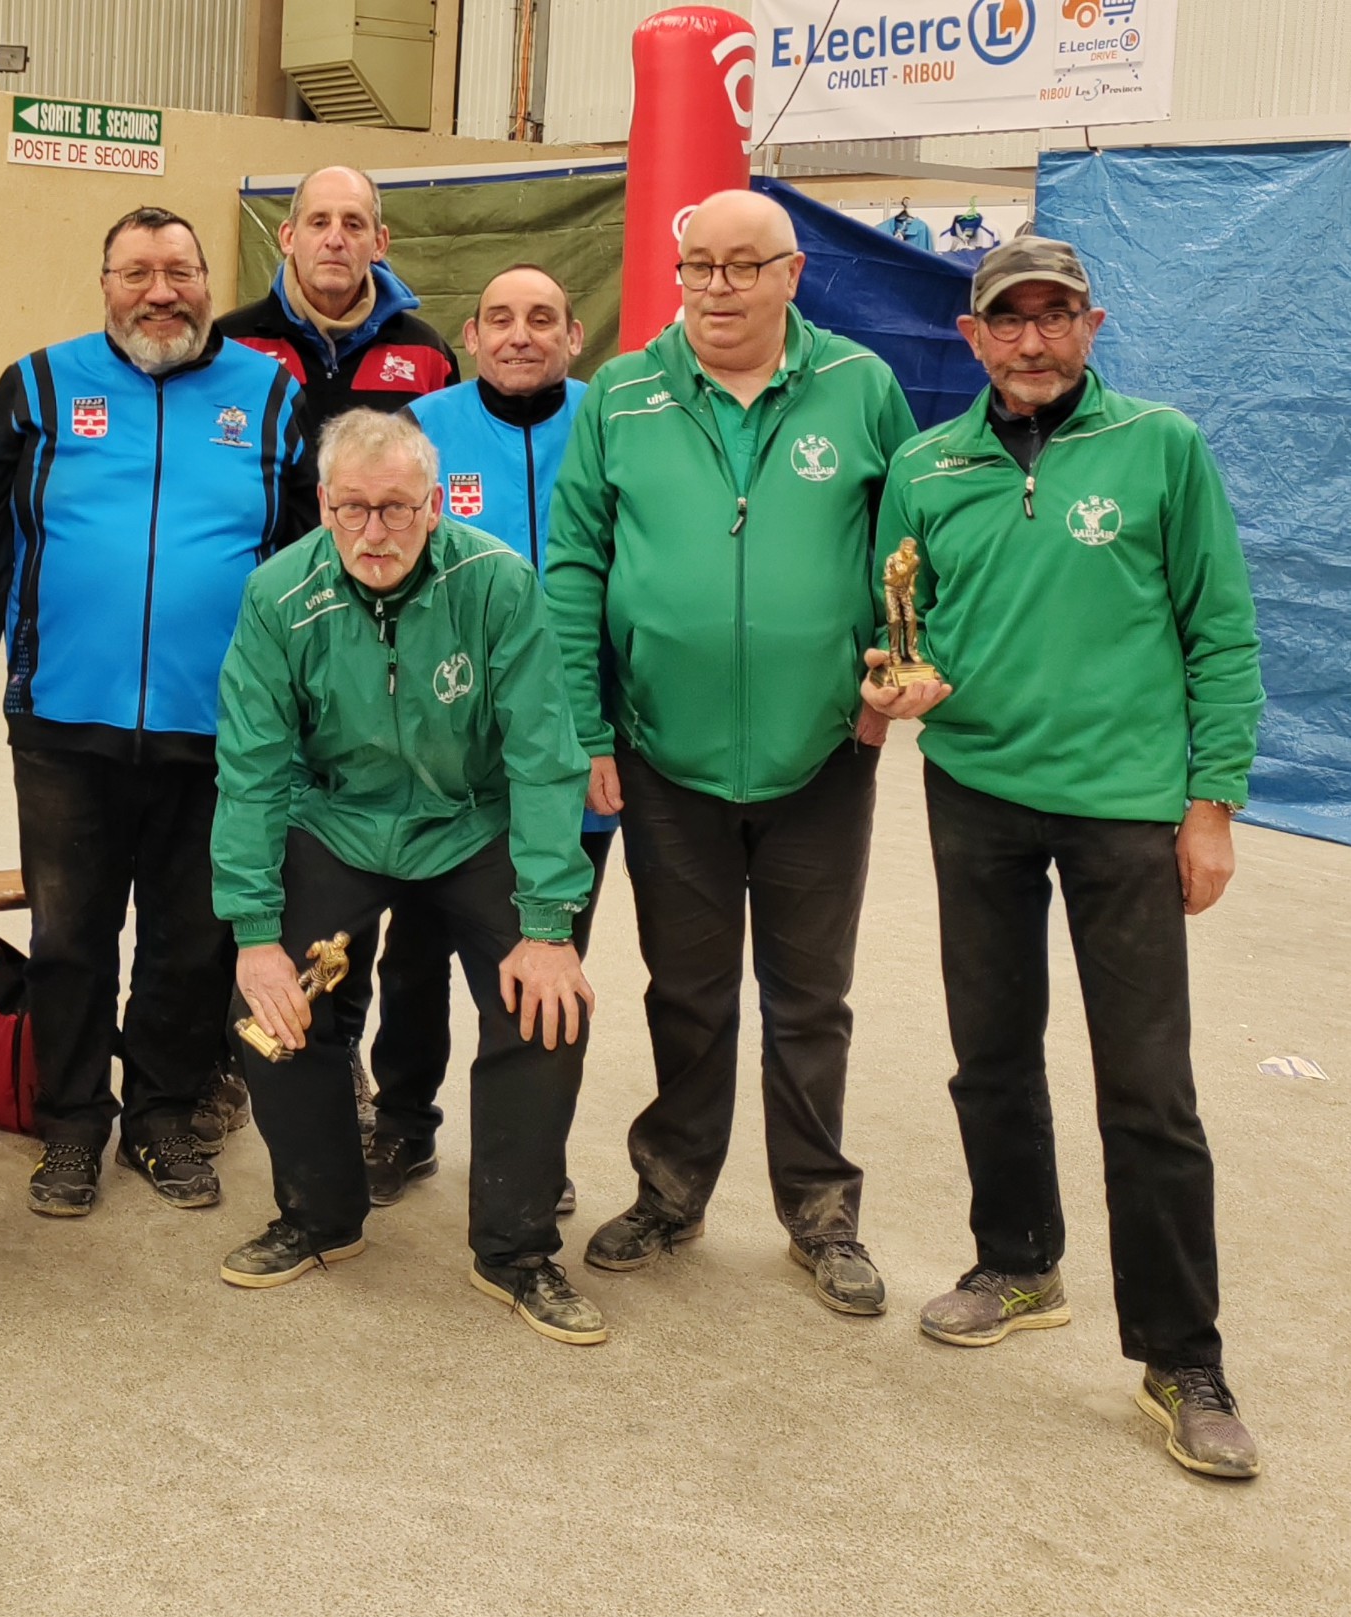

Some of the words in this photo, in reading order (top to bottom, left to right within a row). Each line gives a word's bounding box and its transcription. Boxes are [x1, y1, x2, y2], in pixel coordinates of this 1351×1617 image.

[771, 16, 961, 67] E.Leclerc
[1059, 38, 1118, 53] E.Leclerc
[1090, 51, 1117, 61] DRIVE
[827, 67, 888, 90] CHOLET
[903, 61, 955, 84] RIBOU
[1039, 86, 1071, 100] RIBOU
[1075, 86, 1090, 96] Les
[1102, 84, 1143, 94] Provinces
[40, 102, 82, 133] SORTIE
[86, 107, 101, 136] DE
[106, 109, 159, 141] SECOURS
[14, 138, 61, 162] POSTE
[68, 144, 87, 163] DE
[95, 146, 159, 169] SECOURS
